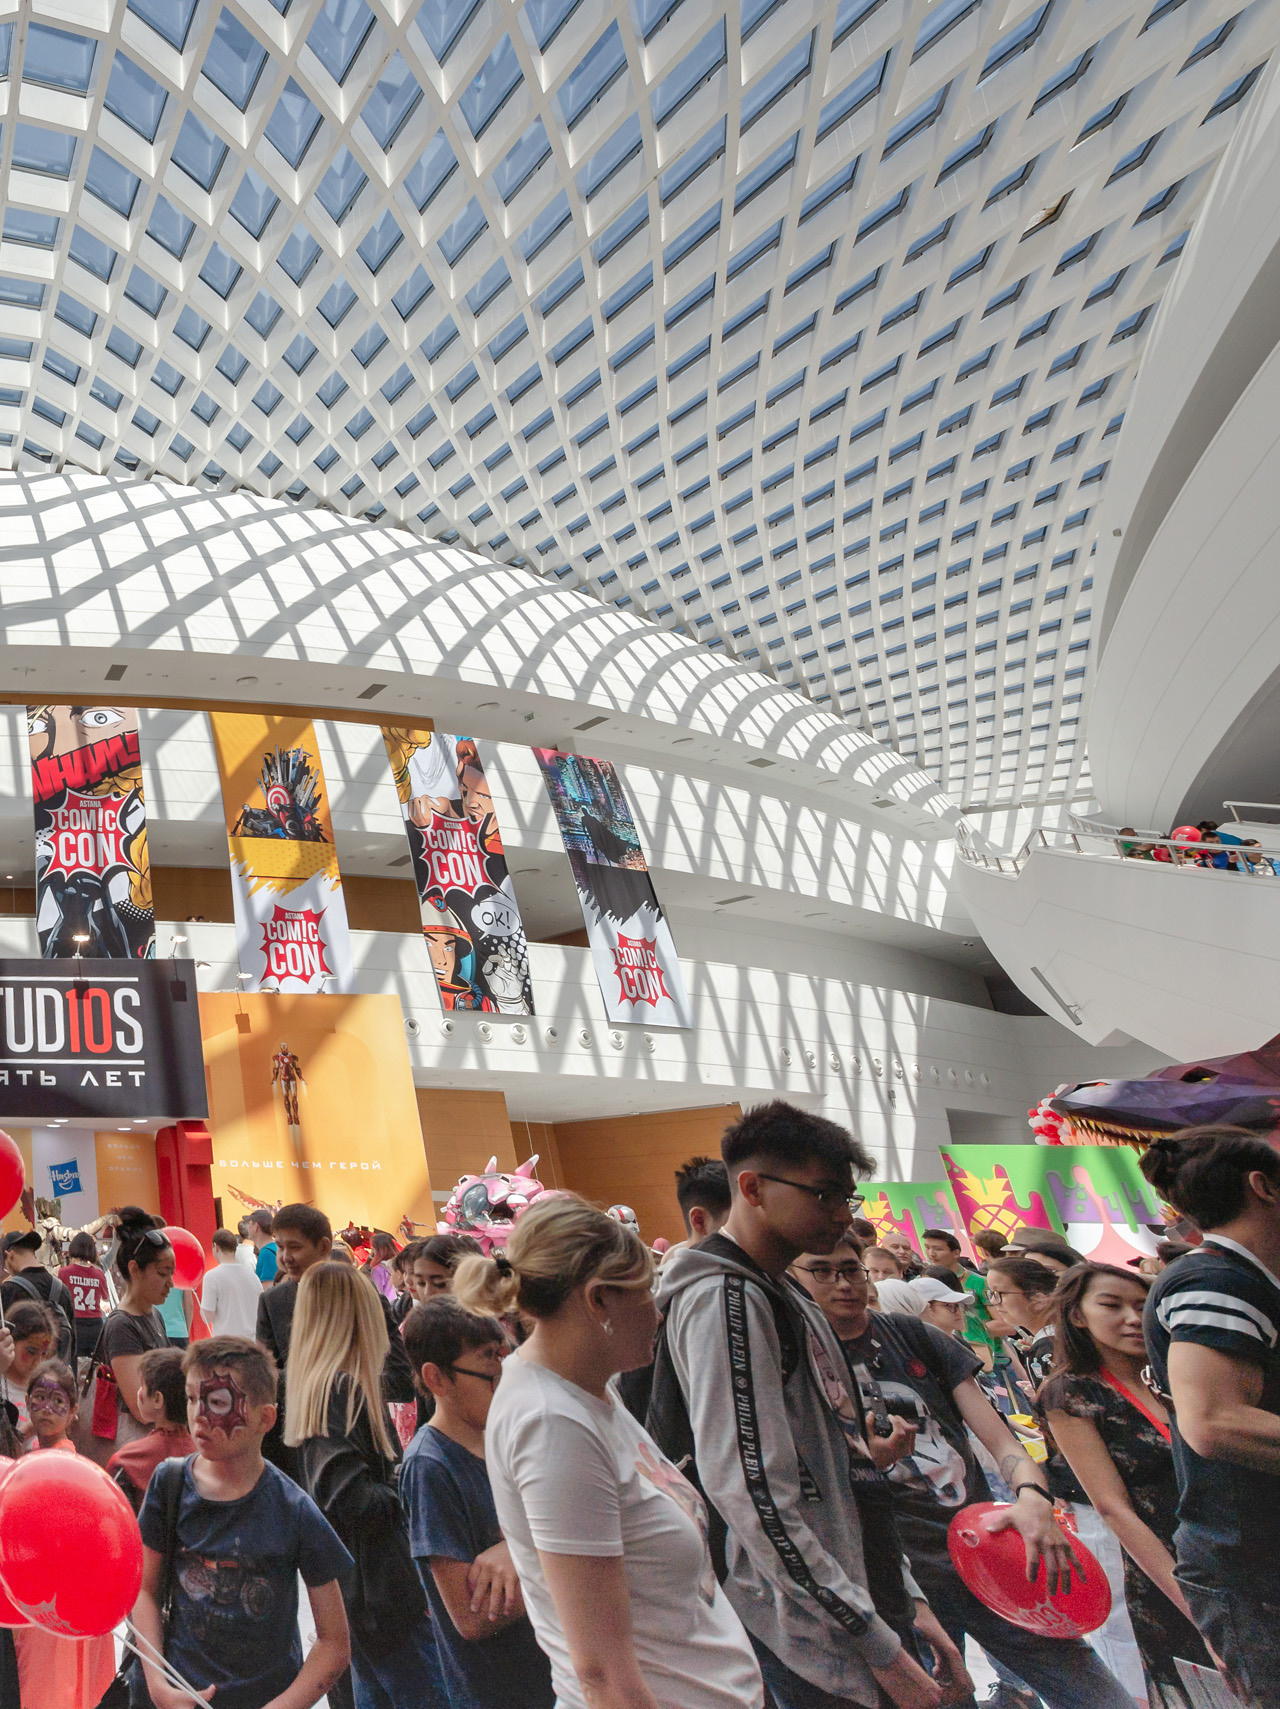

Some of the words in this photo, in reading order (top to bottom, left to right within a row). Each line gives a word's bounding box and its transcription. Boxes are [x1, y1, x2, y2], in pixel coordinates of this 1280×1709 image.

[58, 832, 116, 867] CON
[431, 851, 483, 886] CON
[482, 911, 510, 930] OK!
[269, 942, 321, 976] CON
[621, 967, 663, 1000] CON
[80, 1070, 146, 1087] ЛЕТ
[51, 1169, 80, 1182] Hasbro
[219, 1159, 284, 1169] БОЛЬШЕ
[291, 1161, 322, 1169] ЧЕМ
[329, 1160, 382, 1170] ГЕРОЙ
[69, 1275, 100, 1288] STILINSKI
[73, 1286, 97, 1311] 24
[731, 1333, 747, 1372] PLEIN
[742, 1440, 760, 1481] PLEIN
